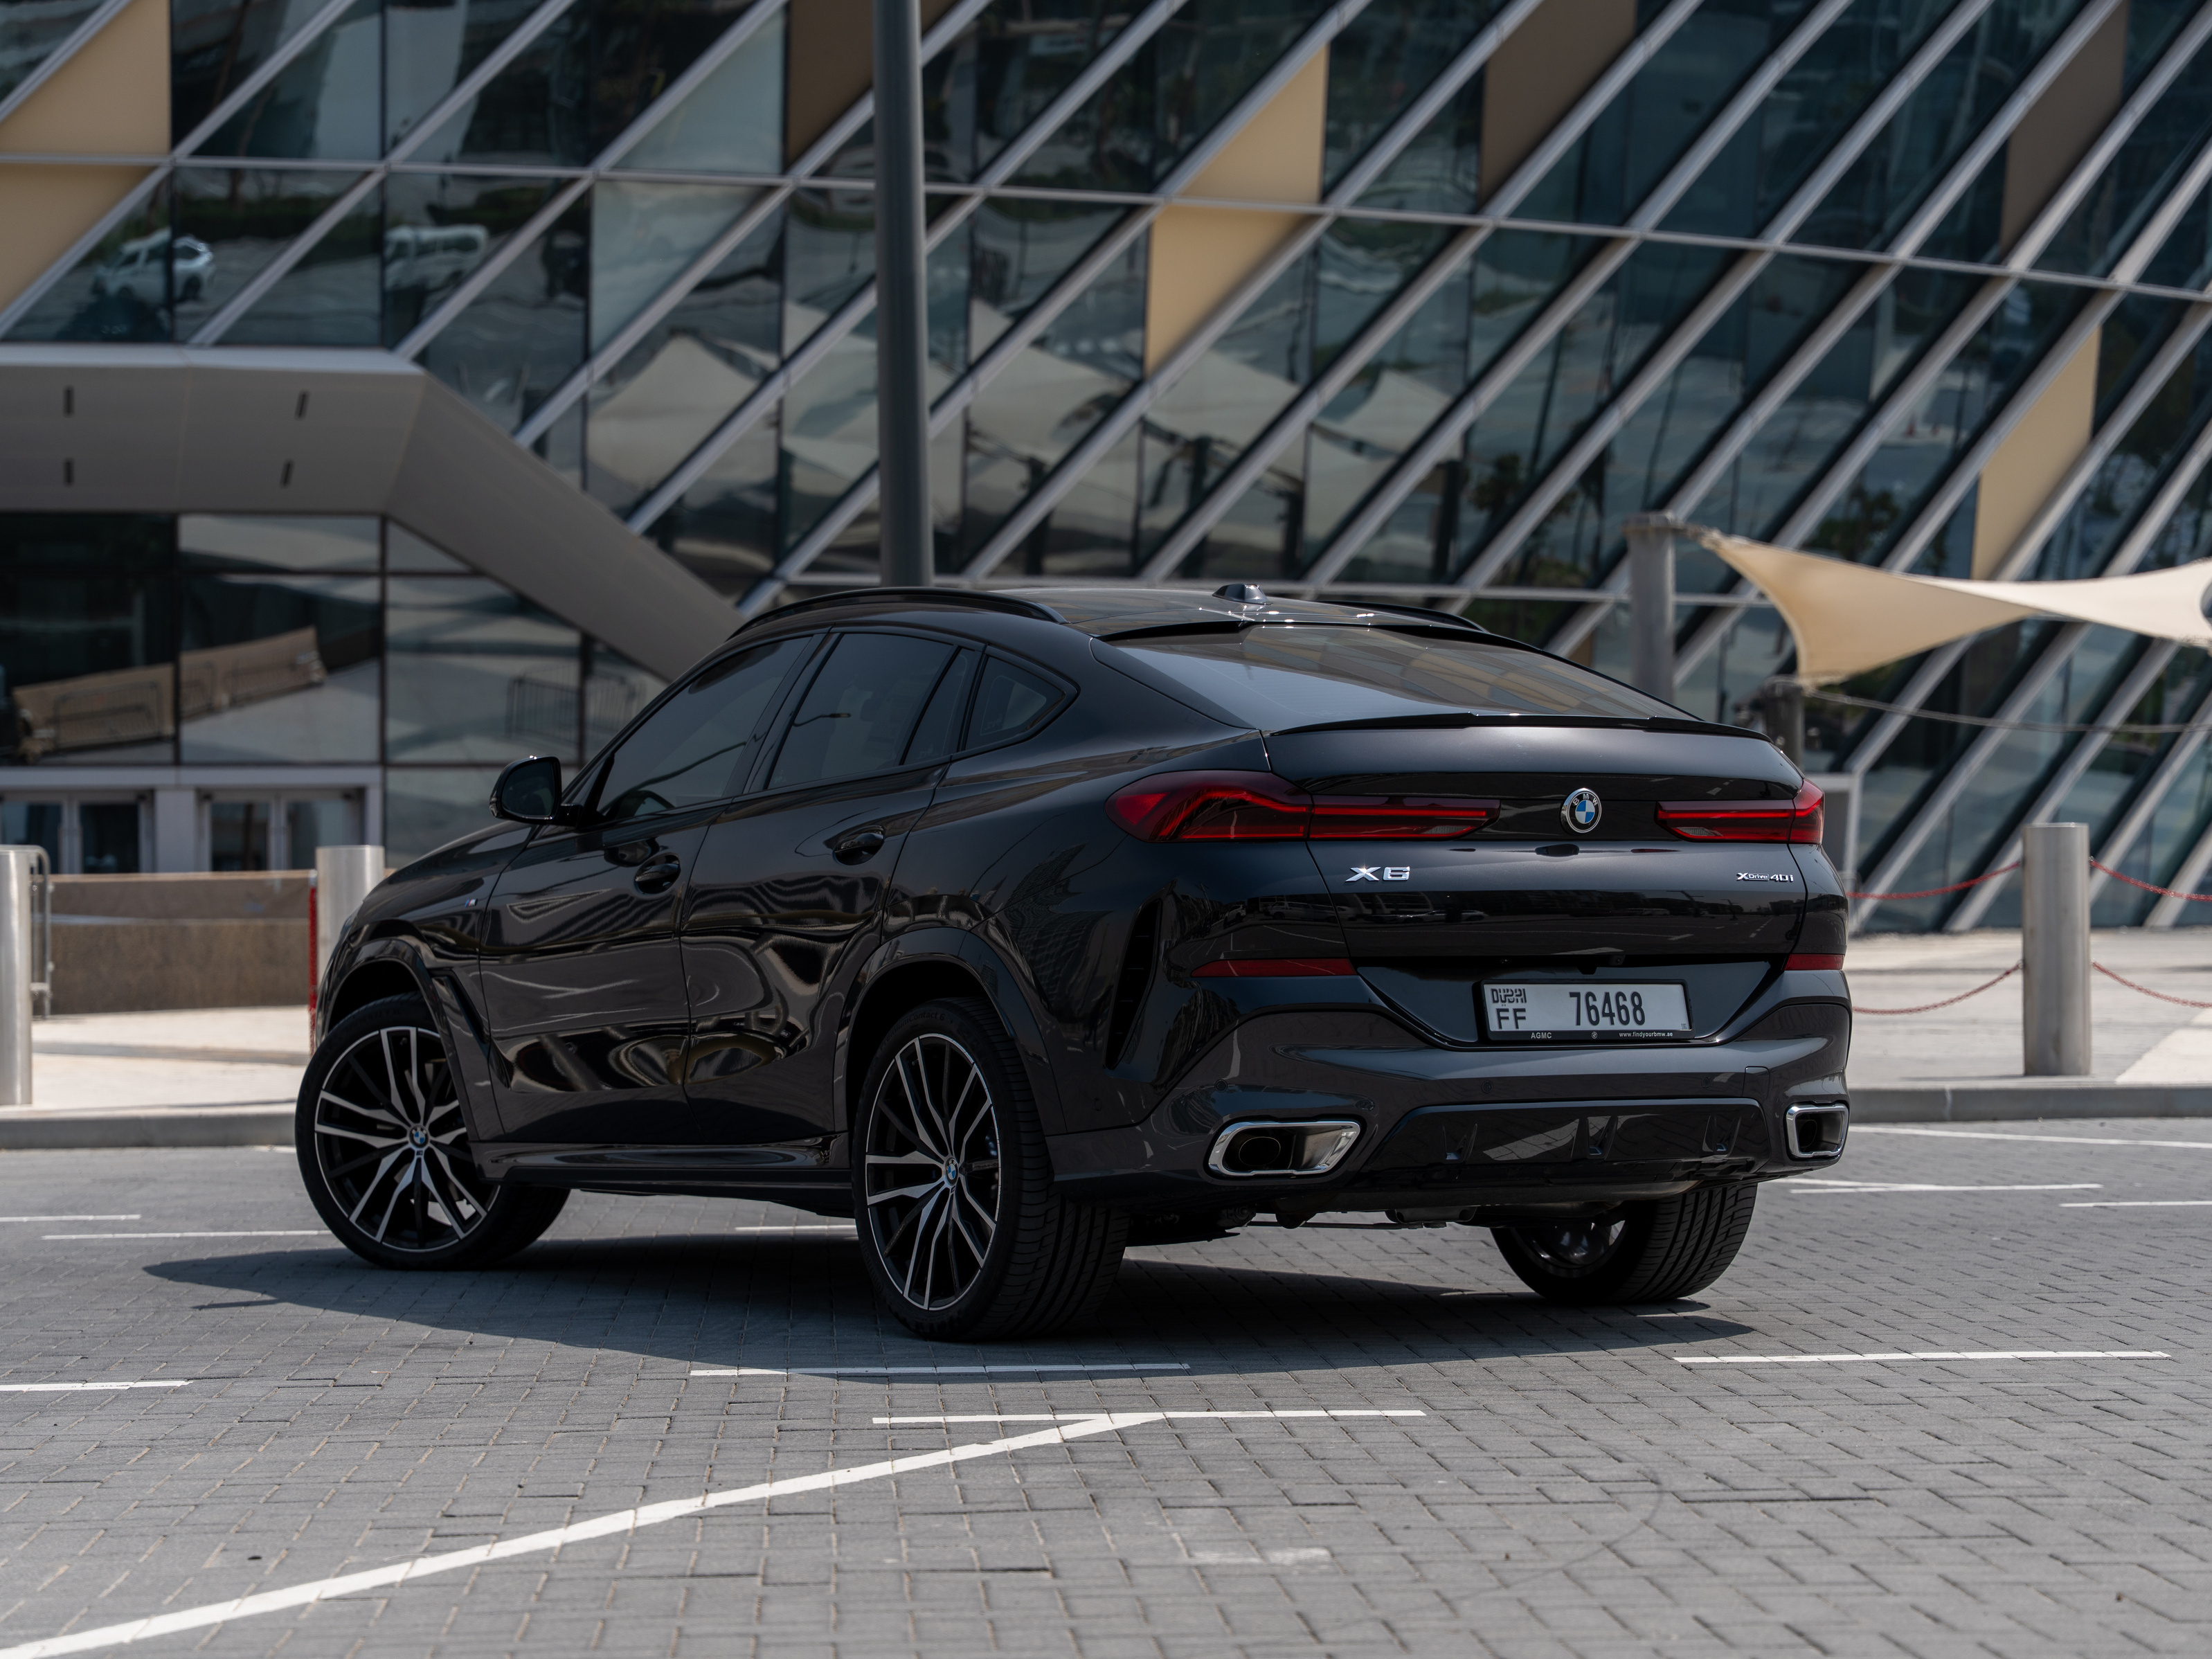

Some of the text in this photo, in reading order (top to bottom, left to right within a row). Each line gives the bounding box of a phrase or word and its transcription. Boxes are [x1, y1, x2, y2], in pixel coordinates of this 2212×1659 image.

[1573, 793, 1598, 806] BMW
[1345, 866, 1410, 882] X6
[939, 1013, 946, 1021] 6
[1496, 991, 1646, 1030] FF 76468
